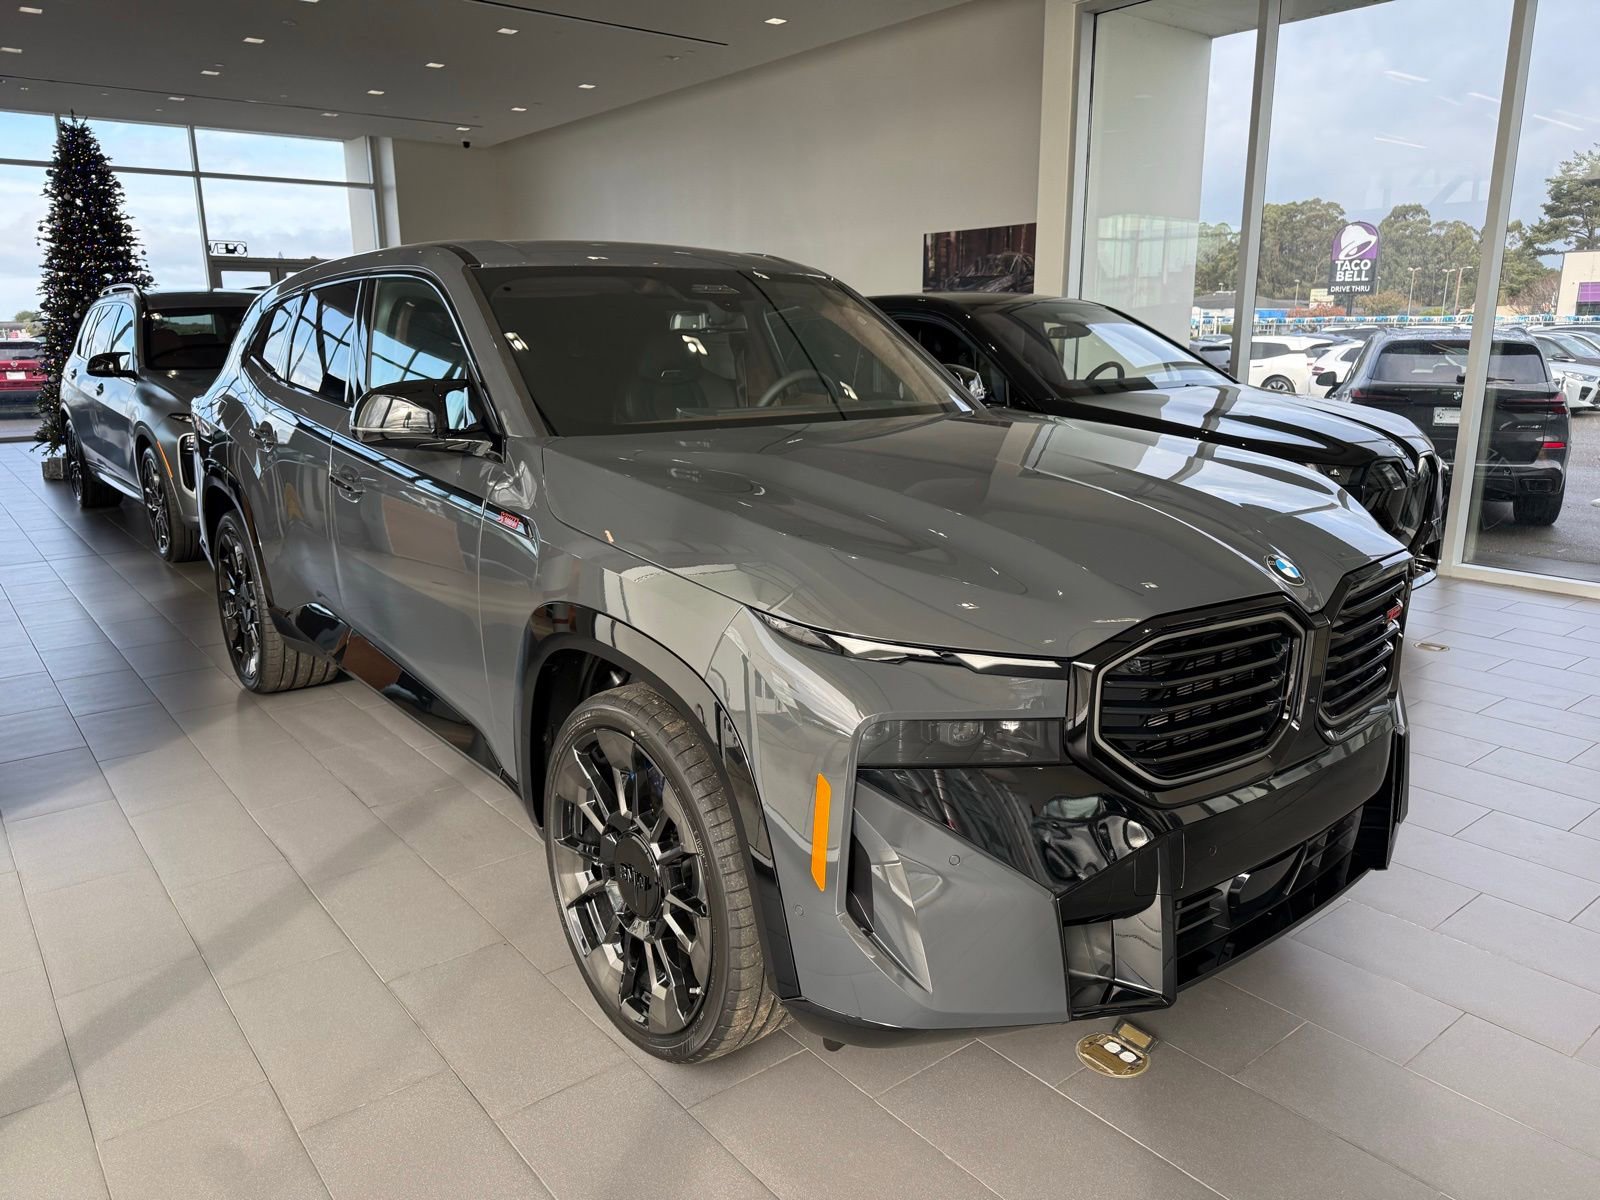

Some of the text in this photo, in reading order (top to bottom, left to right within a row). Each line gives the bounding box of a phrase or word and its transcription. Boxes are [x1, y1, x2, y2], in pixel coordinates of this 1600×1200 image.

[1335, 259, 1371, 271] TACO
[1335, 270, 1369, 282] BELL
[1330, 285, 1350, 293] DRIVE
